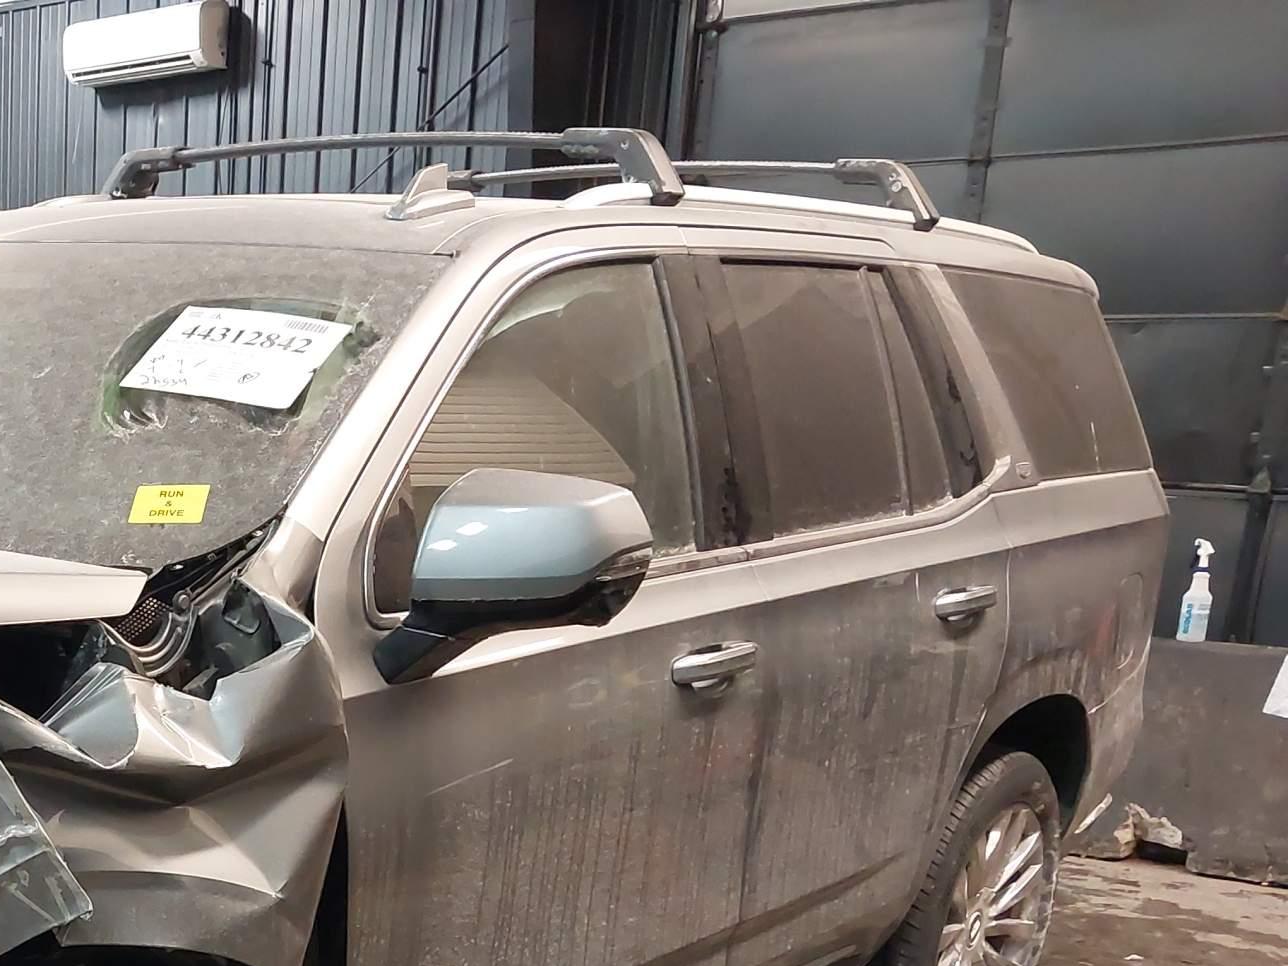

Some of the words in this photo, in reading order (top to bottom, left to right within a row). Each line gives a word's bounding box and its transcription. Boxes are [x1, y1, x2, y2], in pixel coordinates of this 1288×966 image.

[181, 324, 313, 354] 44312842
[159, 490, 184, 498] RUN
[148, 509, 185, 517] DRIVE
